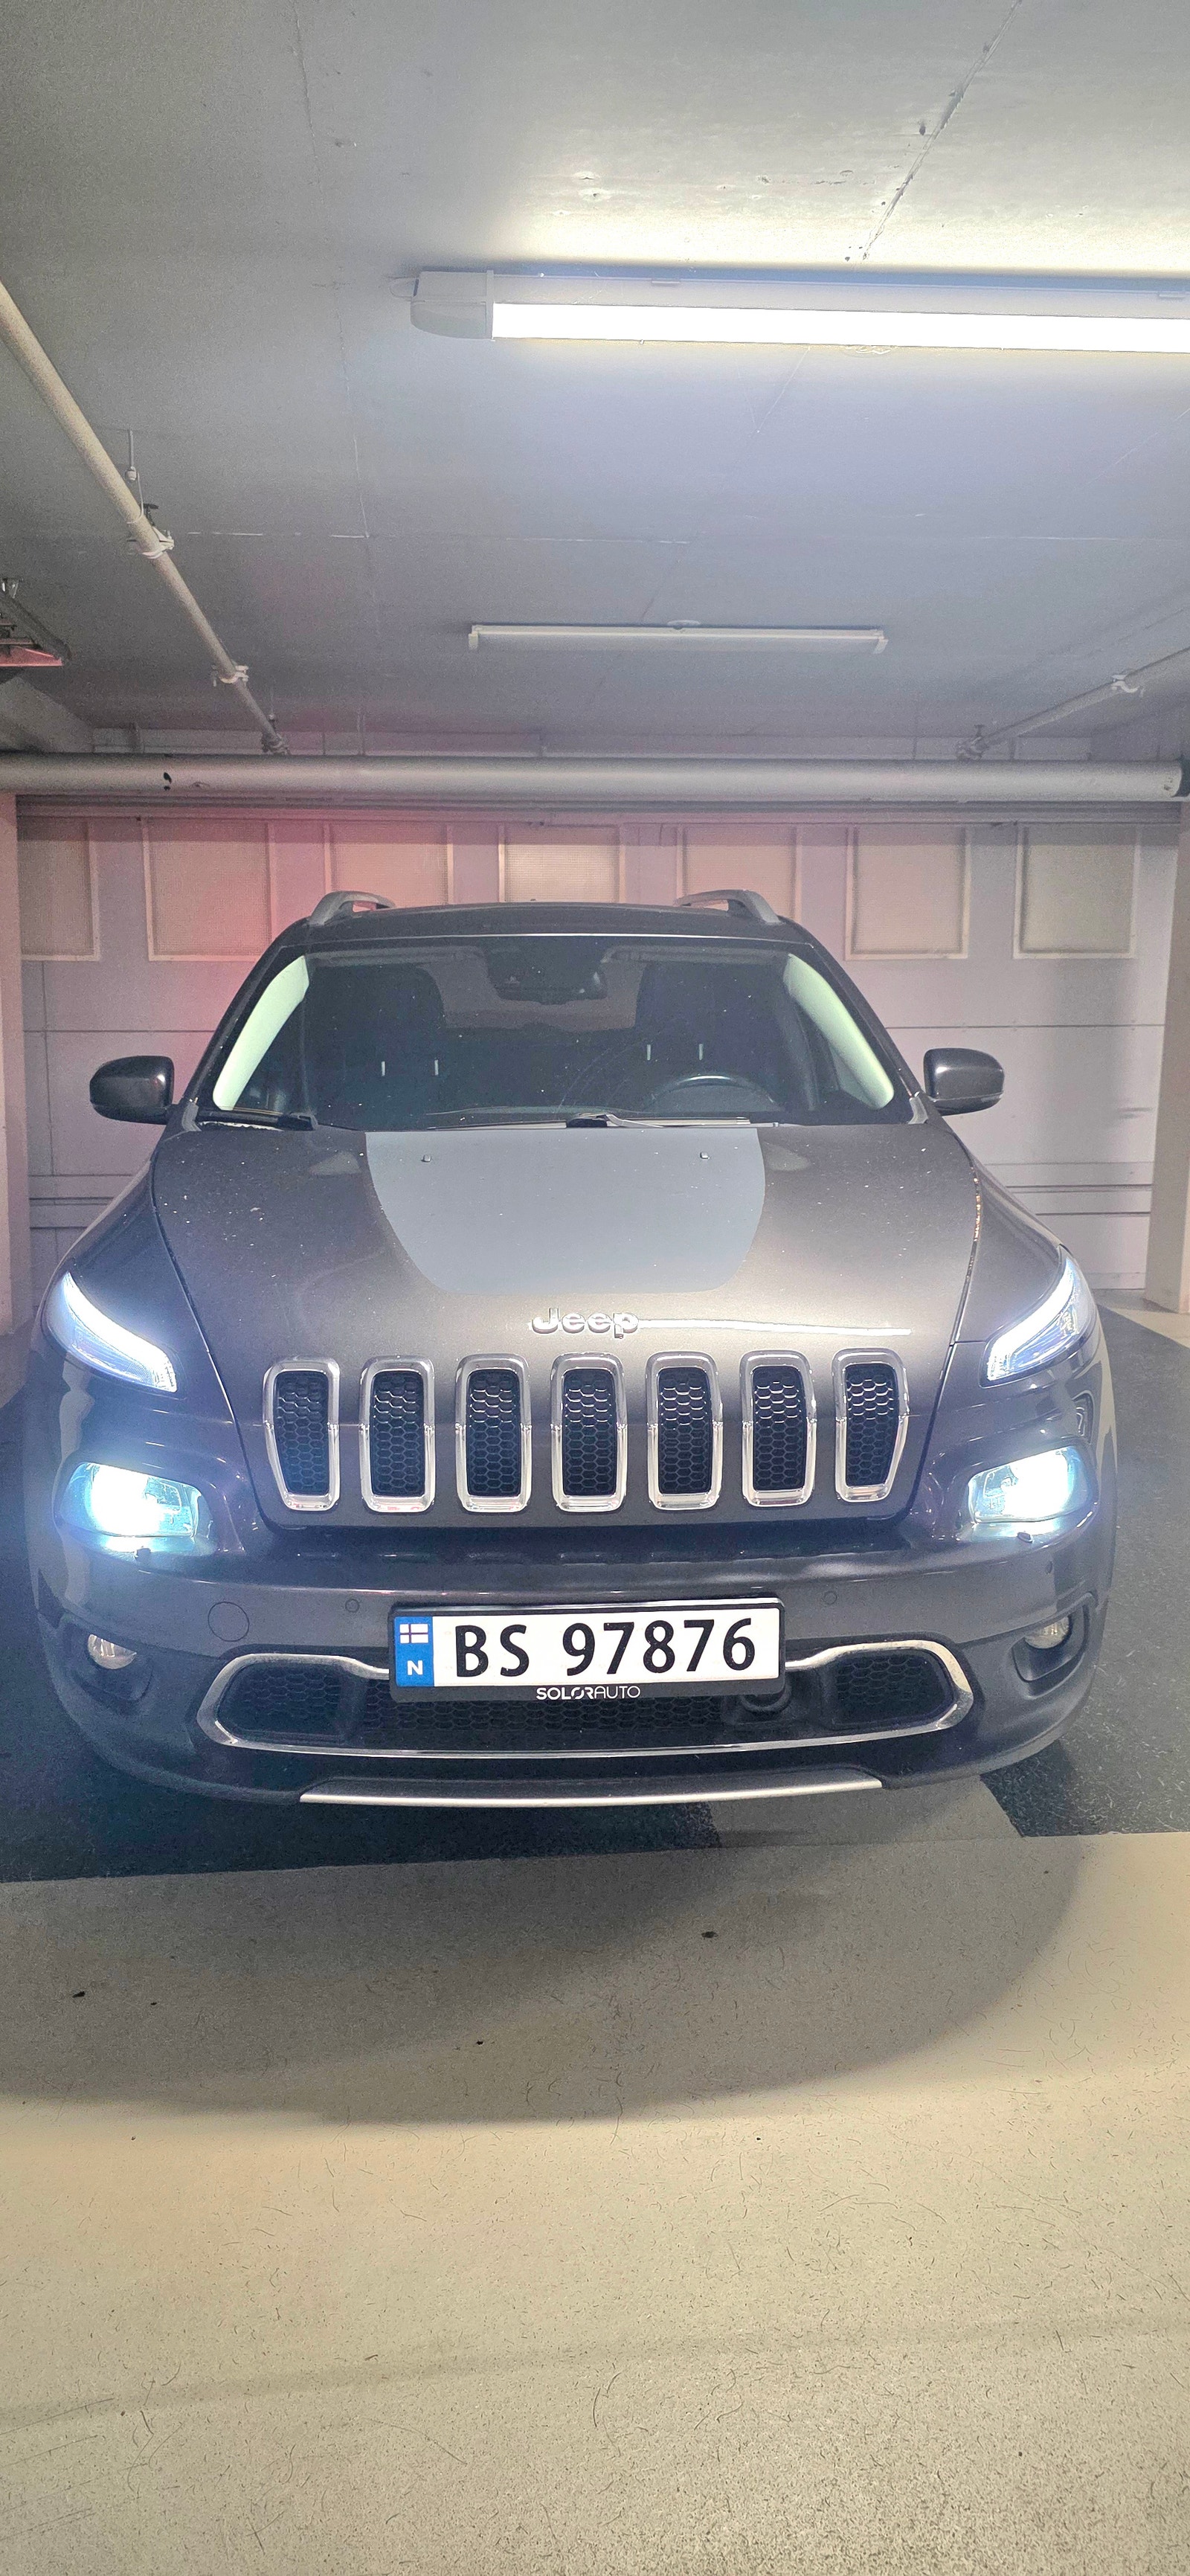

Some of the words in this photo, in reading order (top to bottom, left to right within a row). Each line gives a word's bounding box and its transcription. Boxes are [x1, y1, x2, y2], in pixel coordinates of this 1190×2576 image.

[531, 1307, 640, 1339] Jeep
[455, 1624, 530, 1677] BS
[562, 1618, 755, 1676] 97876
[407, 1660, 423, 1675] N
